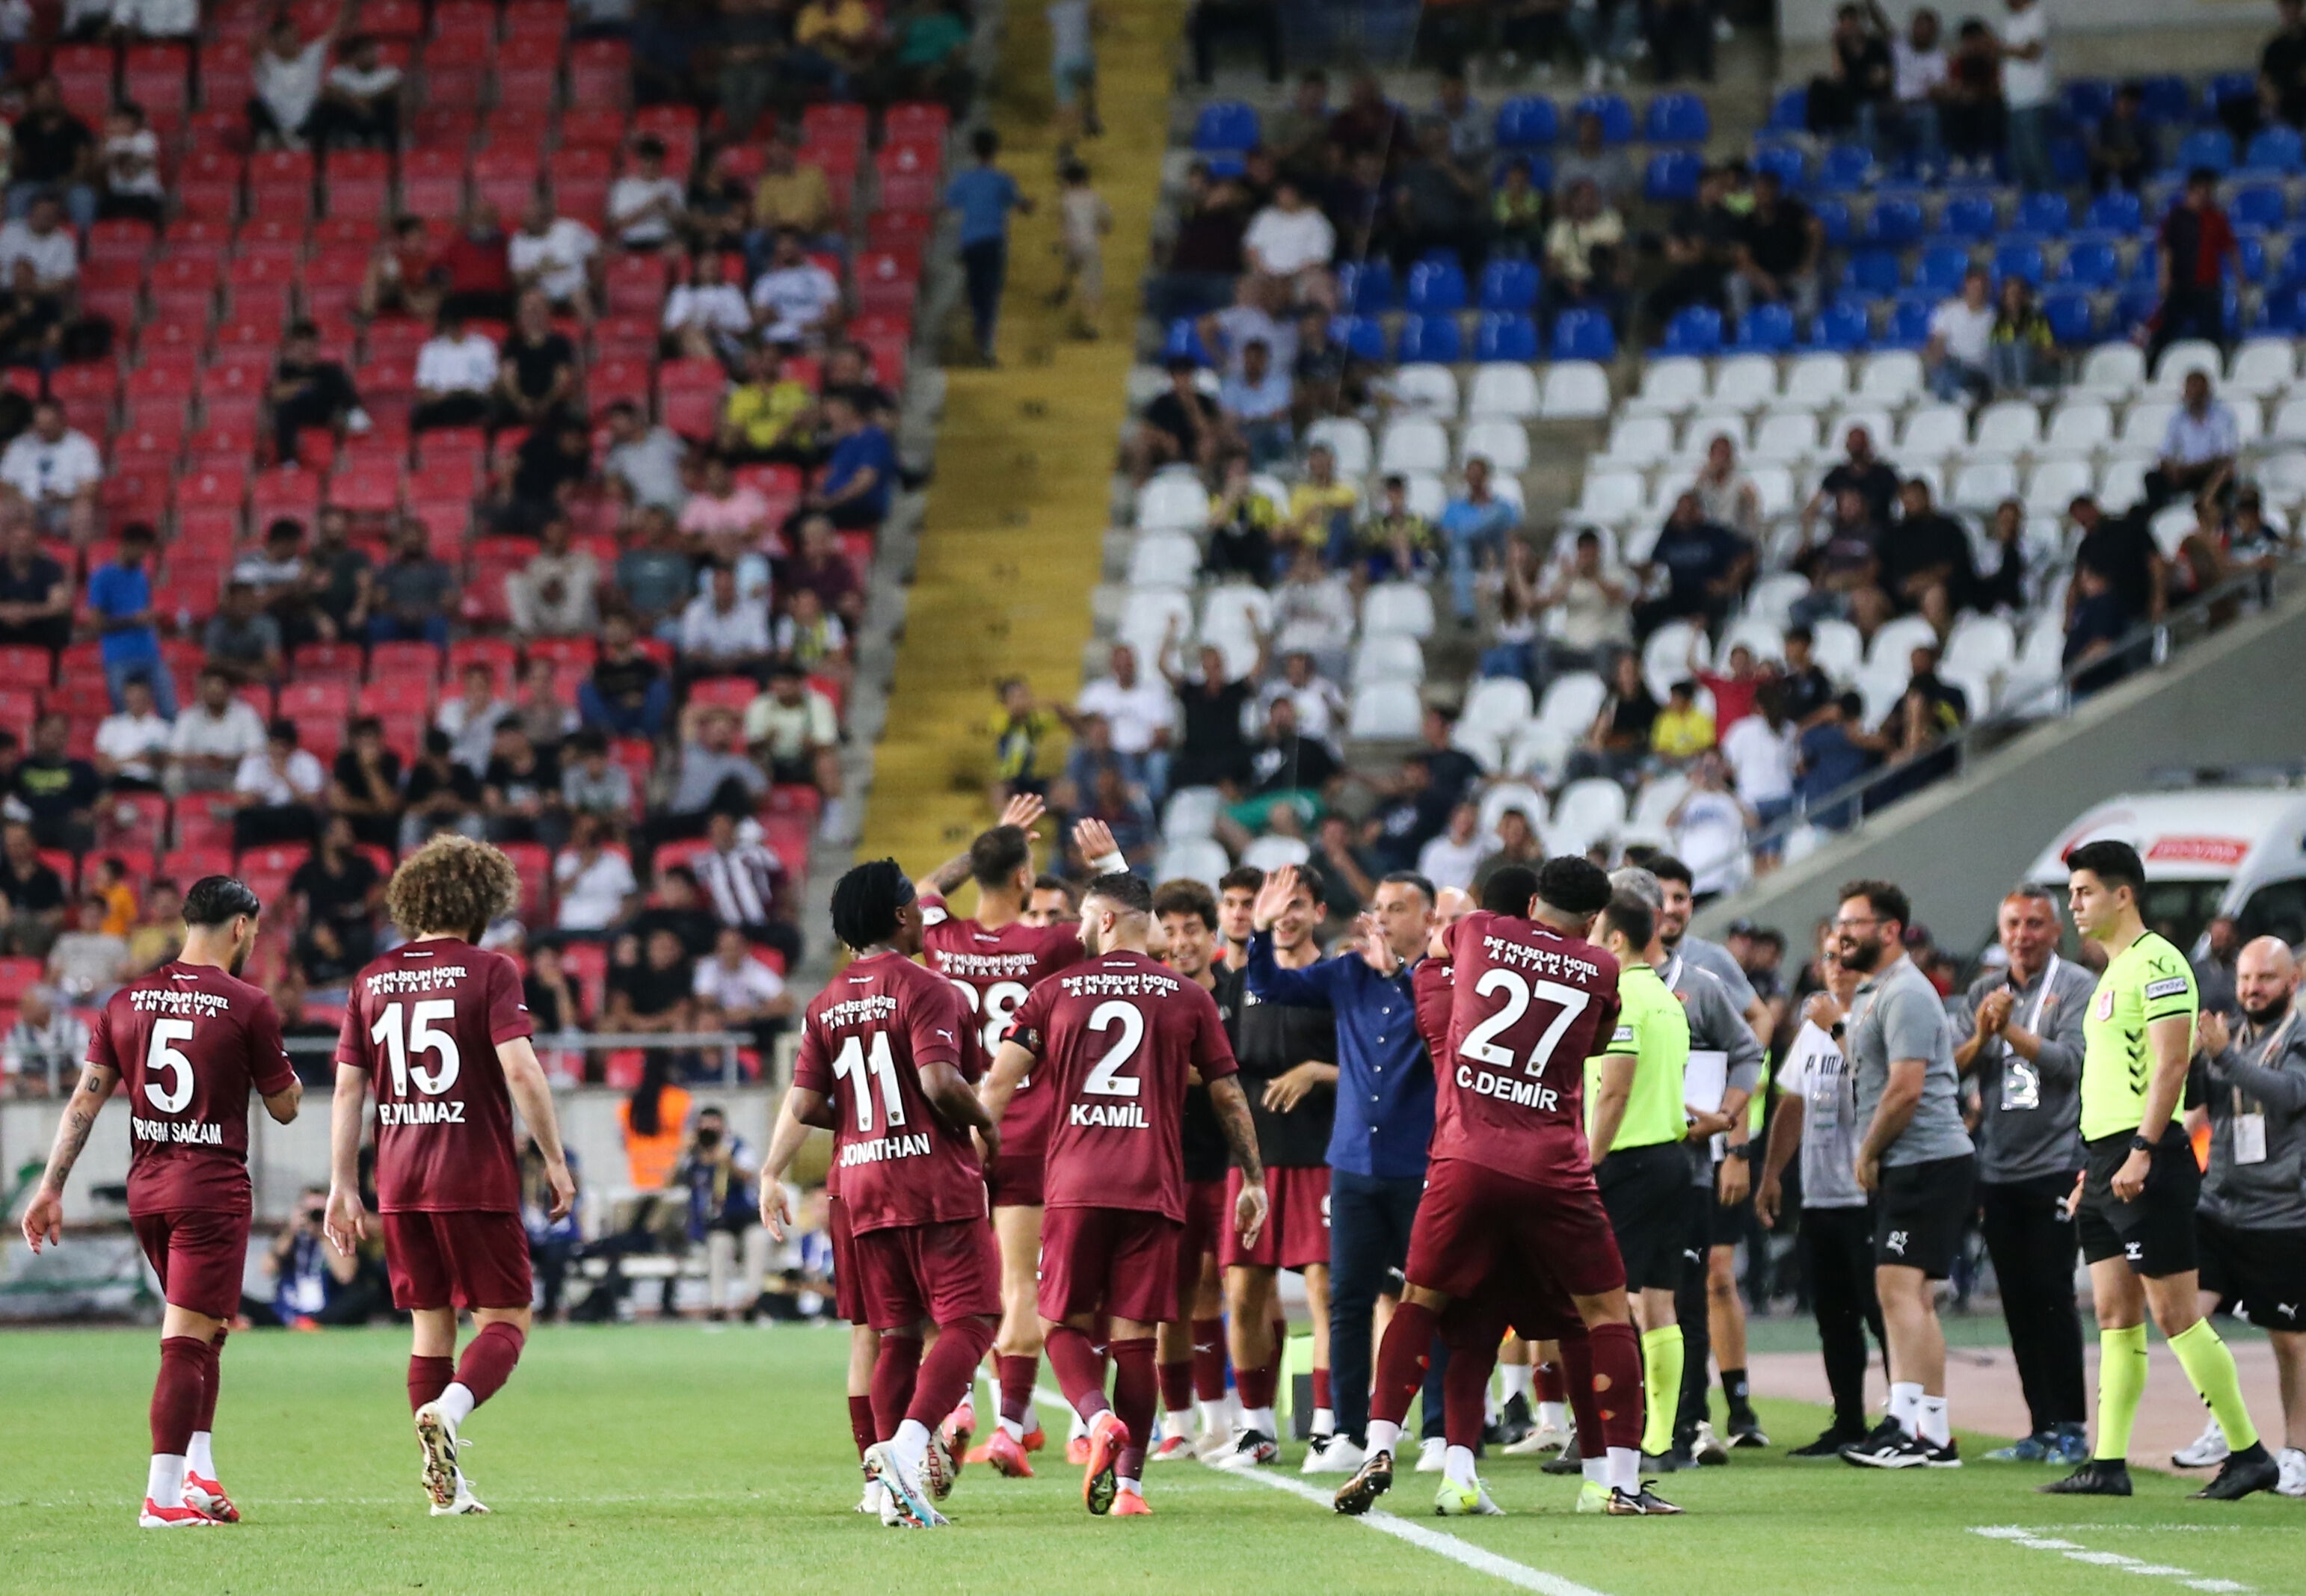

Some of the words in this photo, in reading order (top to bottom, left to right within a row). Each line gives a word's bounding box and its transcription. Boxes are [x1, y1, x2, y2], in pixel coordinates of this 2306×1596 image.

[941, 962, 1030, 976] ANTAKYA
[955, 952, 1001, 967] MUSEUM
[1002, 953, 1038, 967] HOTEL
[1483, 935, 1506, 951] THE
[1506, 940, 1561, 965] MUSEUM
[1563, 954, 1599, 977] HOTEL
[1488, 949, 1588, 985] ANTAKYA
[372, 977, 456, 996] ANTAKYA
[383, 970, 432, 982] MUSEUM
[433, 966, 467, 978] HOTEL
[1061, 976, 1083, 988] THE
[1085, 973, 1140, 986] MUSEUM
[1141, 973, 1180, 991] HOTEL
[147, 989, 193, 1003] MUSEUM
[194, 990, 229, 1010] HOTEL
[1070, 984, 1168, 998] ANTAKYA
[134, 1000, 217, 1018] ANTAKYA
[1458, 967, 1590, 1077] 27
[371, 999, 460, 1097] 15
[1083, 999, 1144, 1097] 2
[144, 1017, 194, 1114] 5
[832, 1030, 906, 1132] 11
[1455, 1064, 1559, 1112] C.DEMİR
[378, 1101, 465, 1125] B.YILMAZ
[1070, 1101, 1149, 1128] KAMİL
[839, 1133, 930, 1168] JONATHAN
